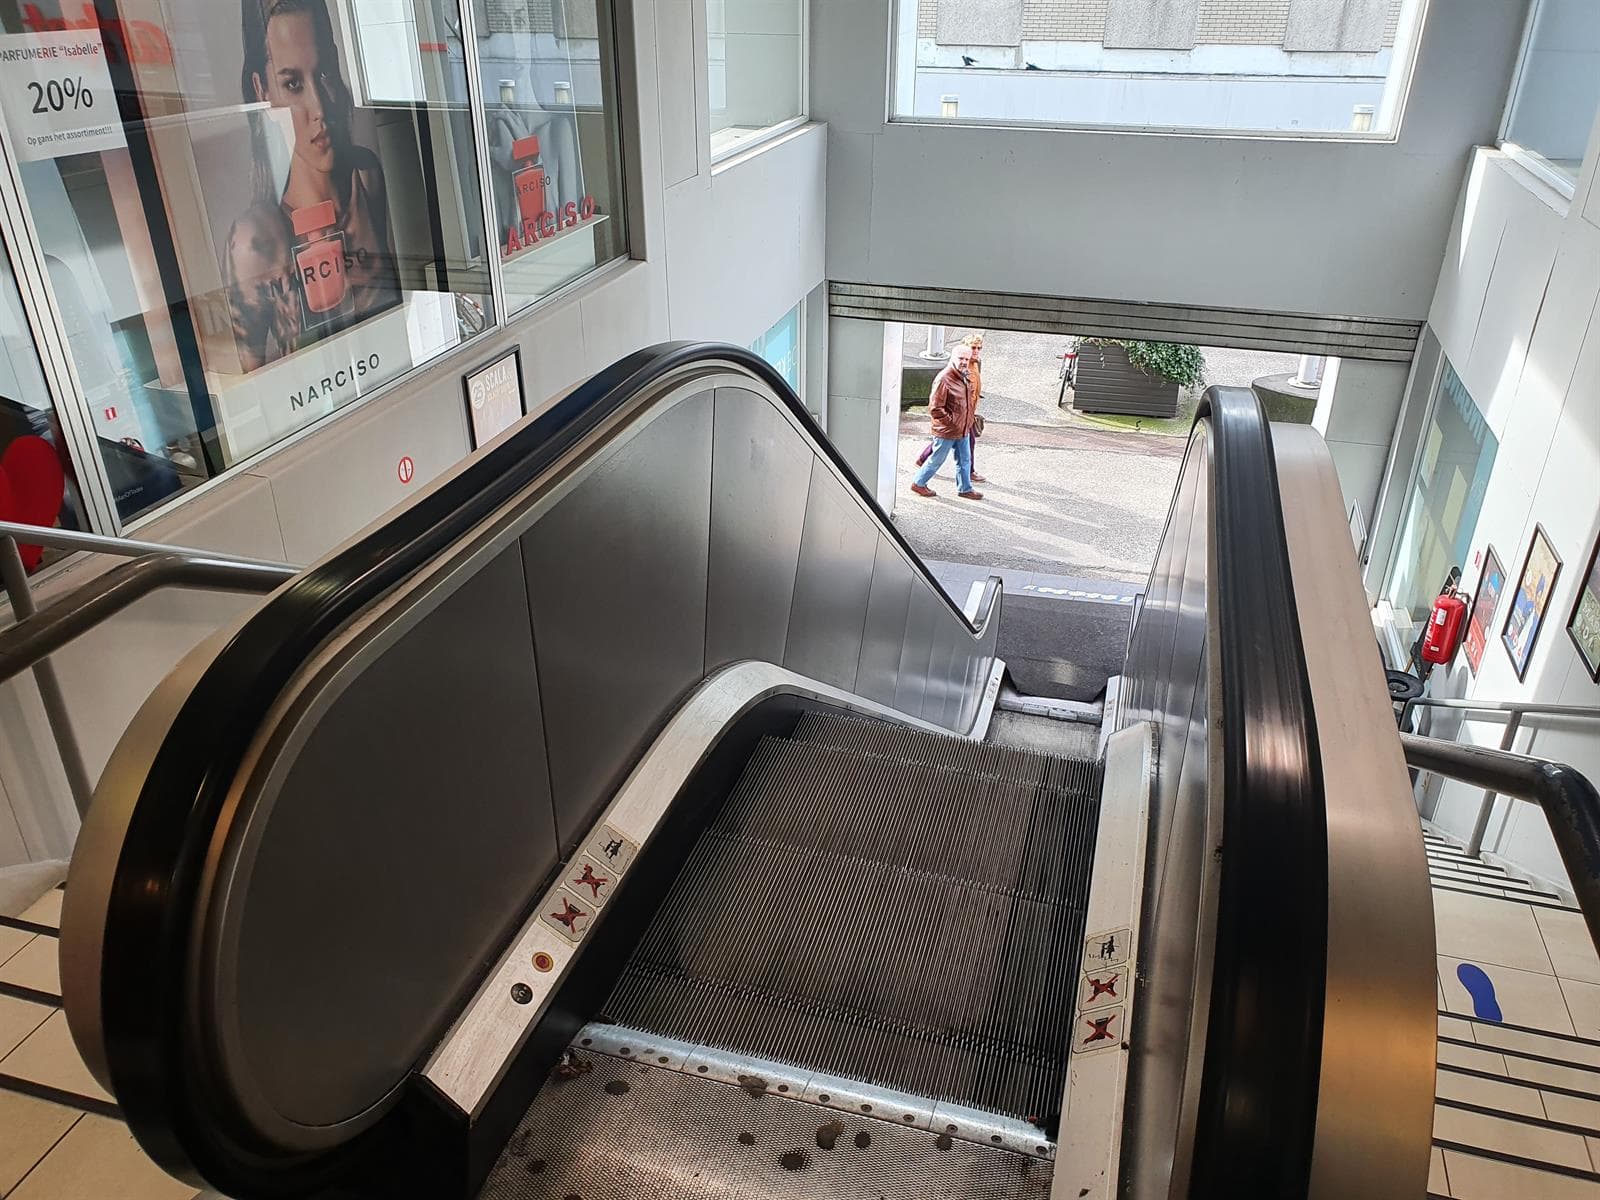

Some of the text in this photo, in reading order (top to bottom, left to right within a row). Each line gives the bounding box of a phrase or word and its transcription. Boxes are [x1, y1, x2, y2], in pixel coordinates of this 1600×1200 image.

[27, 76, 93, 114] 20%
[27, 136, 37, 146] Op
[53, 132, 65, 140] het
[500, 192, 596, 259] ARCISO
[269, 247, 367, 298] NRCISO
[289, 353, 380, 411] NARCISO
